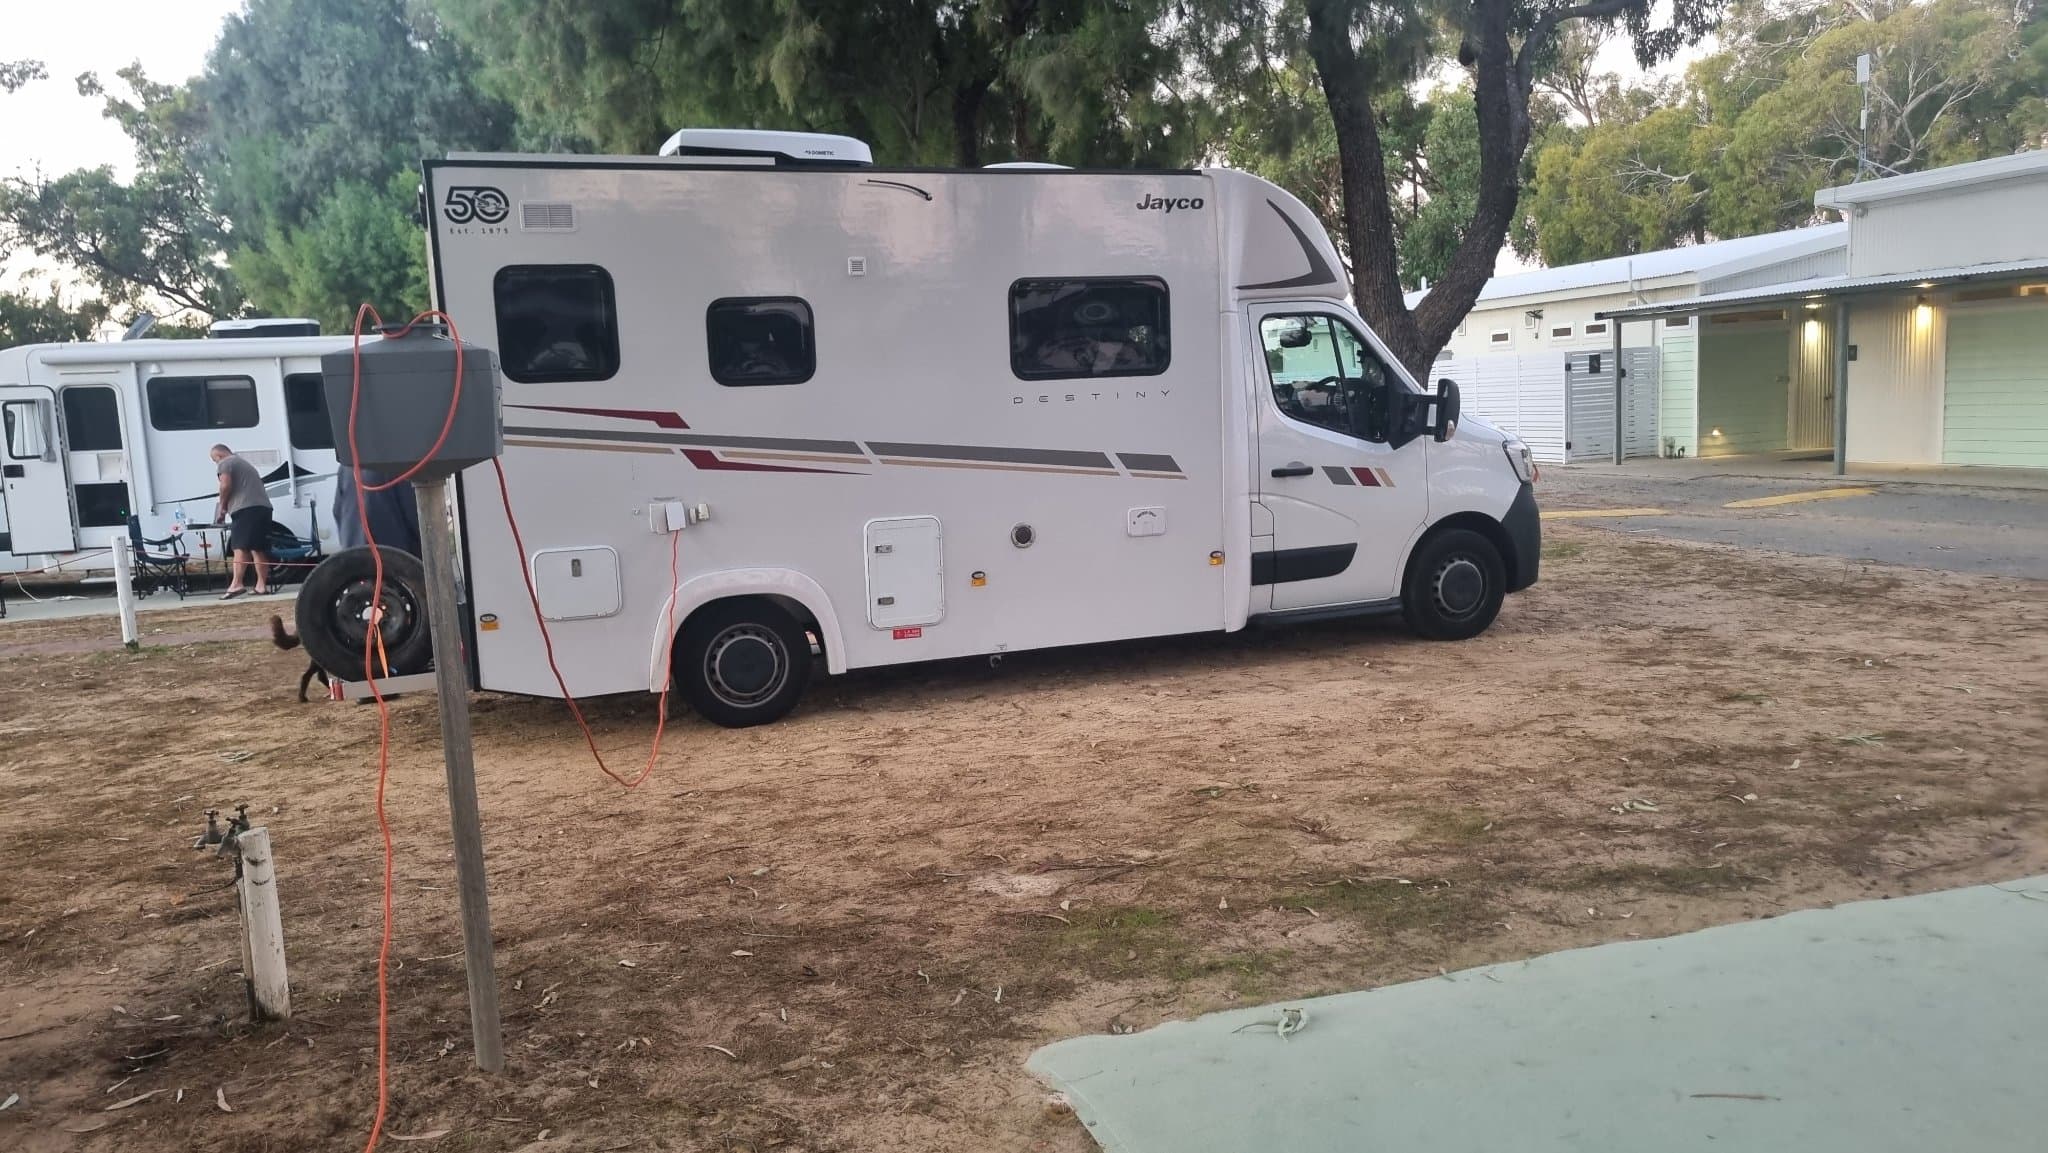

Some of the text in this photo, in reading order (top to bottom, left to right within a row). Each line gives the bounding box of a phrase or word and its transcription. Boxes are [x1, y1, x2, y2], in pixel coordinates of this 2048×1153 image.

[443, 186, 510, 224] 50
[1136, 193, 1204, 213] Jayco
[1013, 390, 1170, 404] DESTINY
